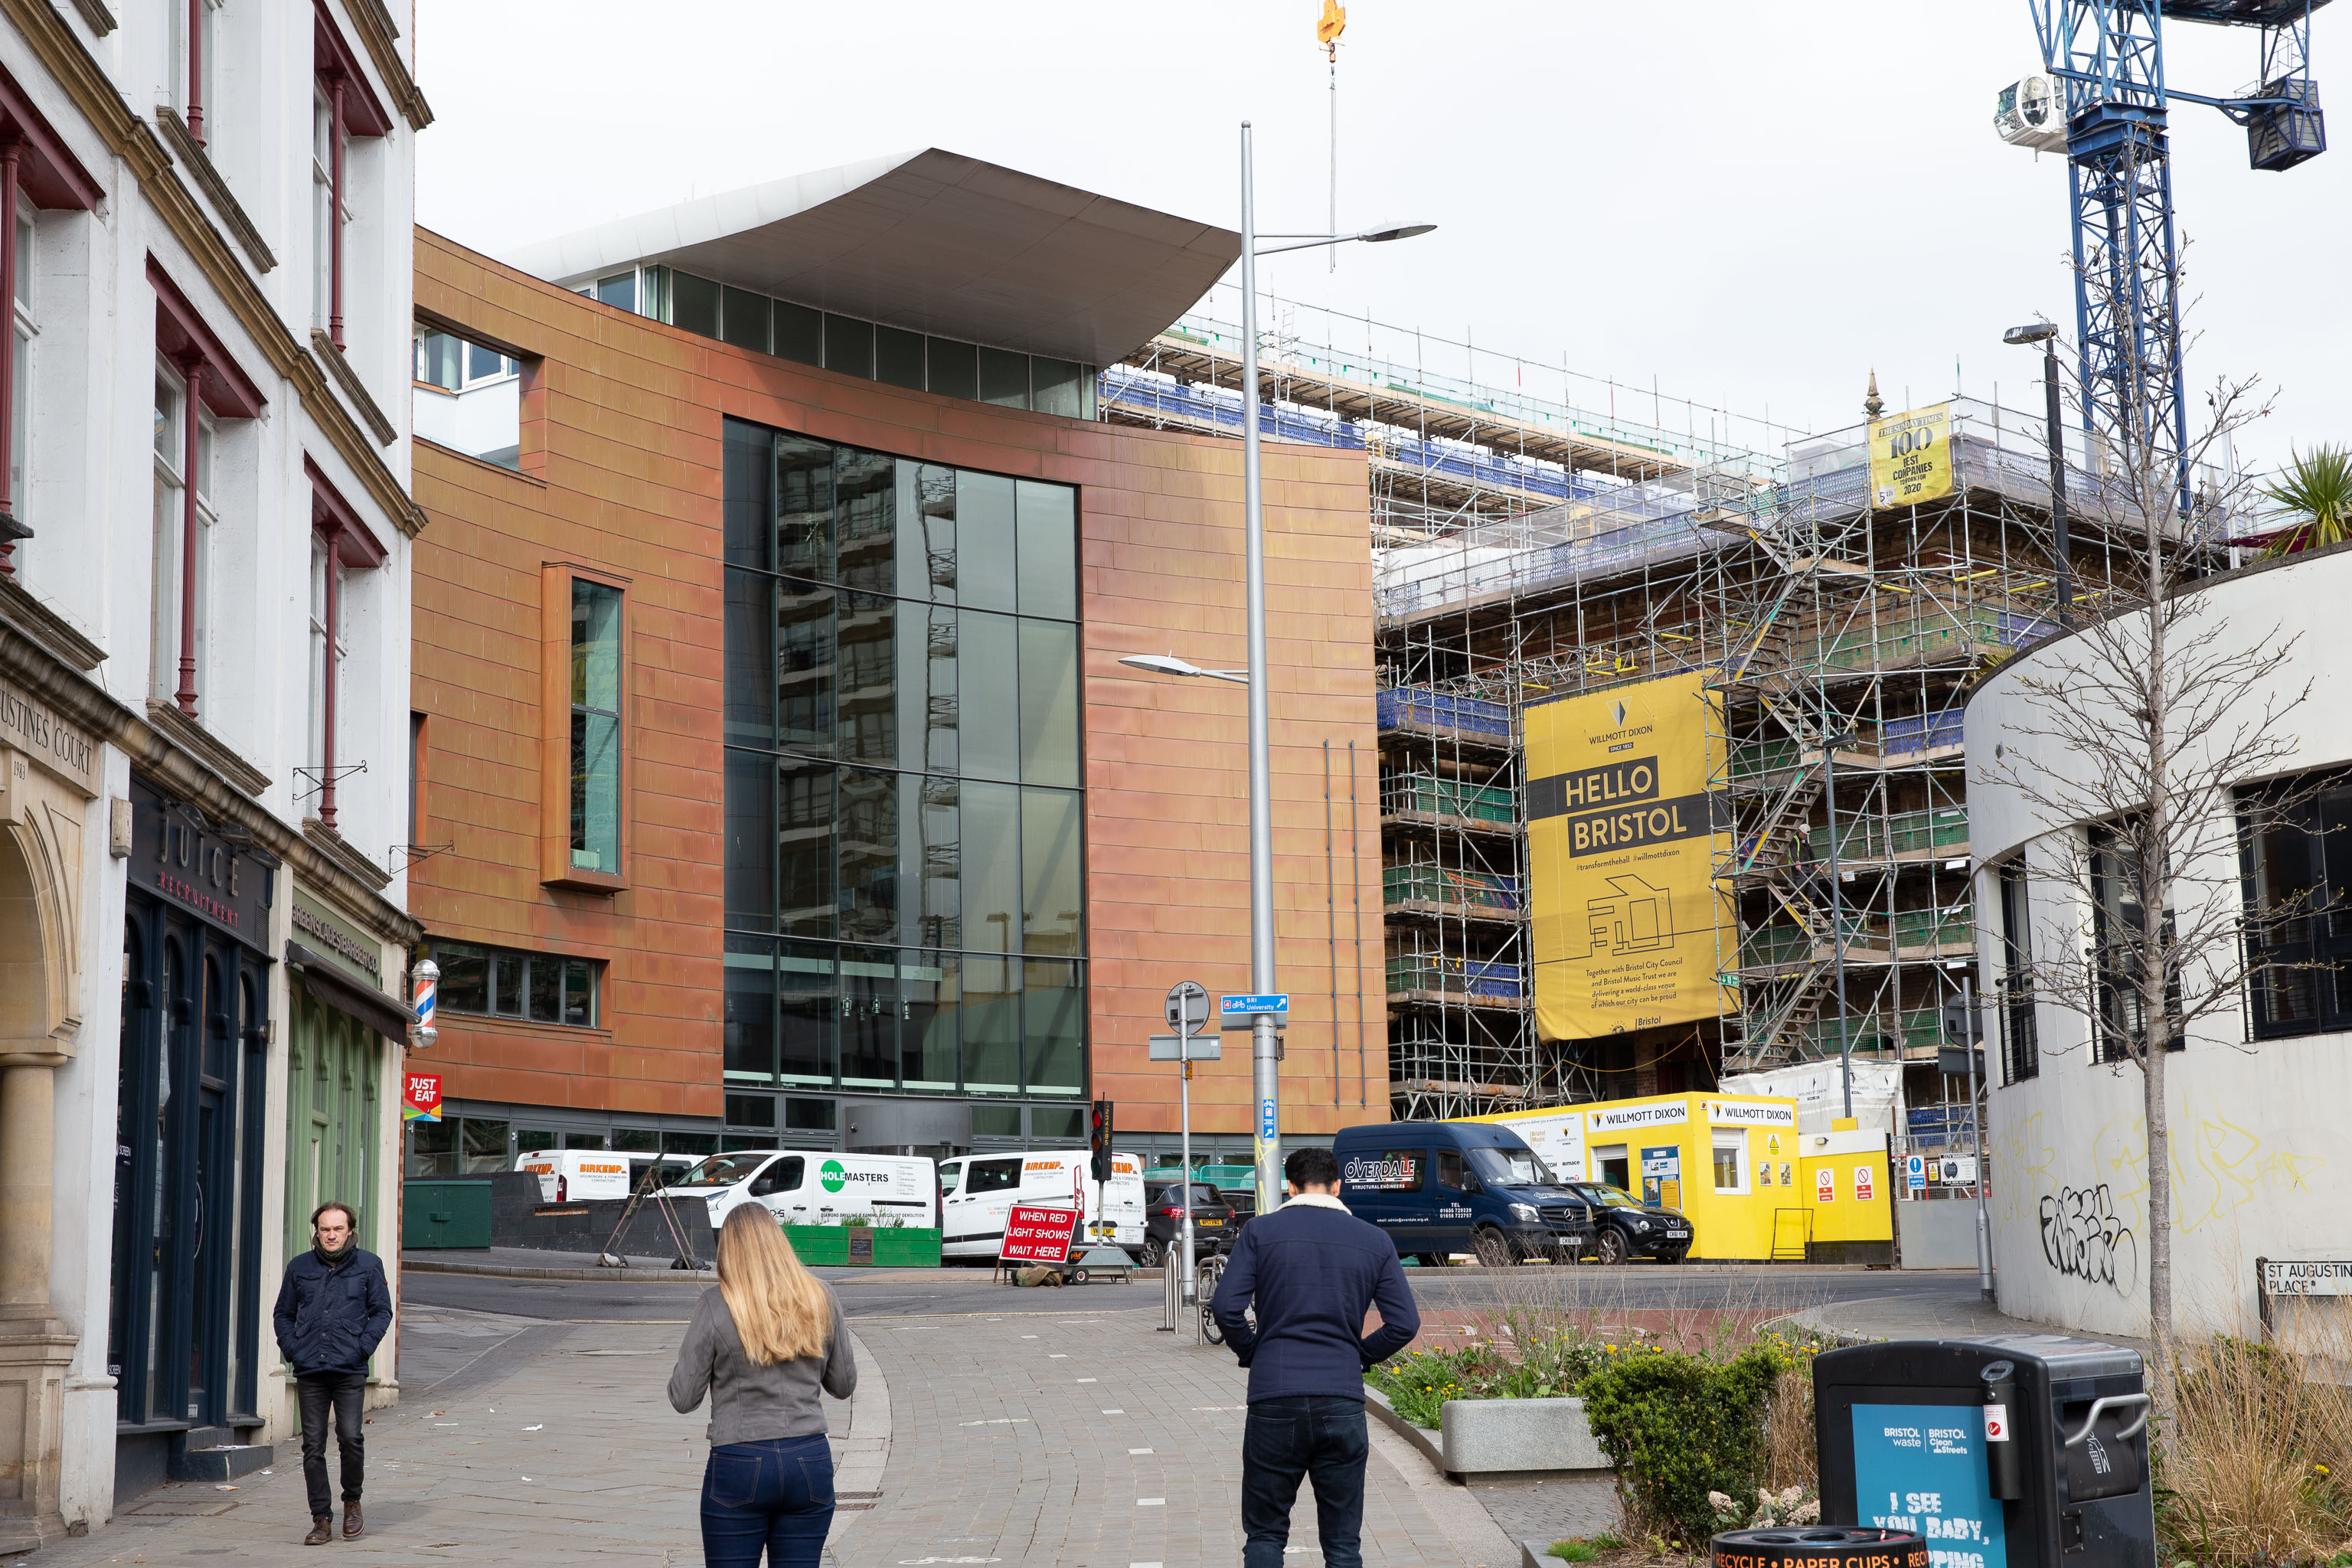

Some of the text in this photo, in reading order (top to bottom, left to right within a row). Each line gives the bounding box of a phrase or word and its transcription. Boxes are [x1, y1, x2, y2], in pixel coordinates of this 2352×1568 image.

[1880, 413, 1943, 437] THE SUNDAY TIMES
[1890, 426, 1933, 459] 100
[1903, 455, 1919, 468] BEST
[1903, 482, 1922, 496] 2020
[0, 689, 92, 776] USTINES COURT
[1589, 725, 1653, 745] WILLMOTT DIXON
[14, 760, 25, 780] 1983
[1565, 765, 1653, 807] HELLO
[1574, 805, 1687, 850] BRISTOL
[160, 815, 240, 897] JUICE
[1576, 849, 1680, 871] #transformthehall #willmottdixon
[160, 871, 239, 929] RECRUITMENT
[292, 903, 343, 949] GREENSLADES
[343, 936, 368, 969] BARBER
[1586, 968, 1610, 978] Together
[1625, 962, 1645, 972] Bristol
[1646, 962, 1658, 970] City
[1660, 957, 1683, 967] Council
[1603, 977, 1622, 985] Bristol
[1623, 974, 1641, 983] Music
[1642, 972, 1657, 981] Trust
[1592, 988, 1619, 998] delivering
[1625, 984, 1657, 993] world-class
[1591, 1001, 1598, 1009] of
[1599, 998, 1615, 1008] which
[1627, 998, 1638, 1006] city
[1659, 991, 1677, 1003] proud
[1638, 1015, 1661, 1026] Bristol
[409, 1077, 436, 1091] JUST
[414, 1089, 436, 1102] EAT
[1606, 1106, 1685, 1125] WILLMOTT DIXON
[1725, 1107, 1792, 1120] WILLMOTT DIXON
[580, 1164, 622, 1174] BIRKEMP
[1024, 1161, 1061, 1171] BIRKEMP
[1111, 1161, 1133, 1174] KEMP
[1344, 1157, 1416, 1180] OVERDALE
[820, 1171, 889, 1182] HOLEMASTERS
[1019, 1210, 1047, 1222] WHEN
[1049, 1213, 1067, 1223] RED
[1008, 1227, 1070, 1240] LIGHT SHOWS
[1009, 1245, 1062, 1258] WAIT HERE
[2269, 1264, 2352, 1278] ST AUGUSTIN
[2269, 1280, 2309, 1293] PLACE
[1884, 1427, 1920, 1437] BRISTOL
[1929, 1429, 1967, 1439] BRISTOL
[1893, 1438, 1921, 1447] waste
[1929, 1439, 1952, 1447] Clean
[1942, 1446, 1968, 1454] Streets
[1890, 1492, 1942, 1514] I SEE
[1873, 1515, 1990, 1545] YOU BABY,
[1846, 1555, 1890, 1568] CUPS
